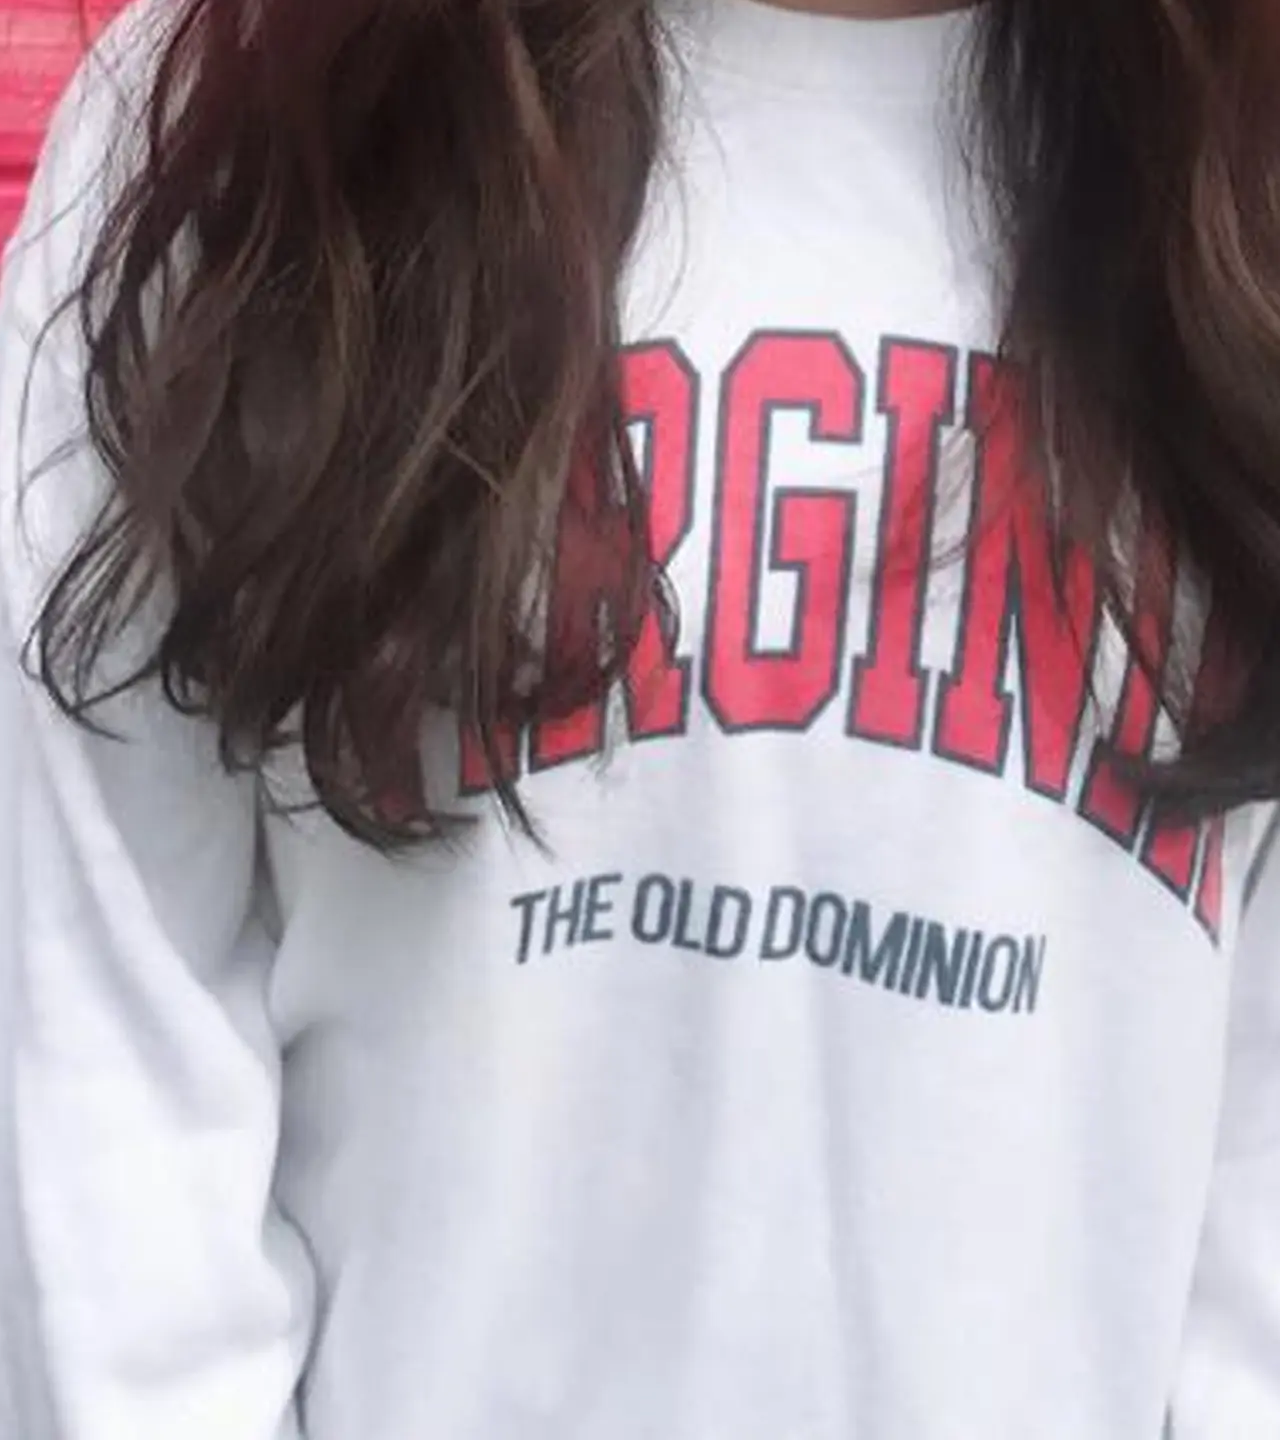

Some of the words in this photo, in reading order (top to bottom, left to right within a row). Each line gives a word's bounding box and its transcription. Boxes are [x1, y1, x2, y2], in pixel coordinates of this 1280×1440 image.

[375, 328, 1223, 948] RGIN
[510, 873, 623, 964] THE
[631, 873, 752, 959] OLD
[759, 885, 1046, 1014] DOMINION
